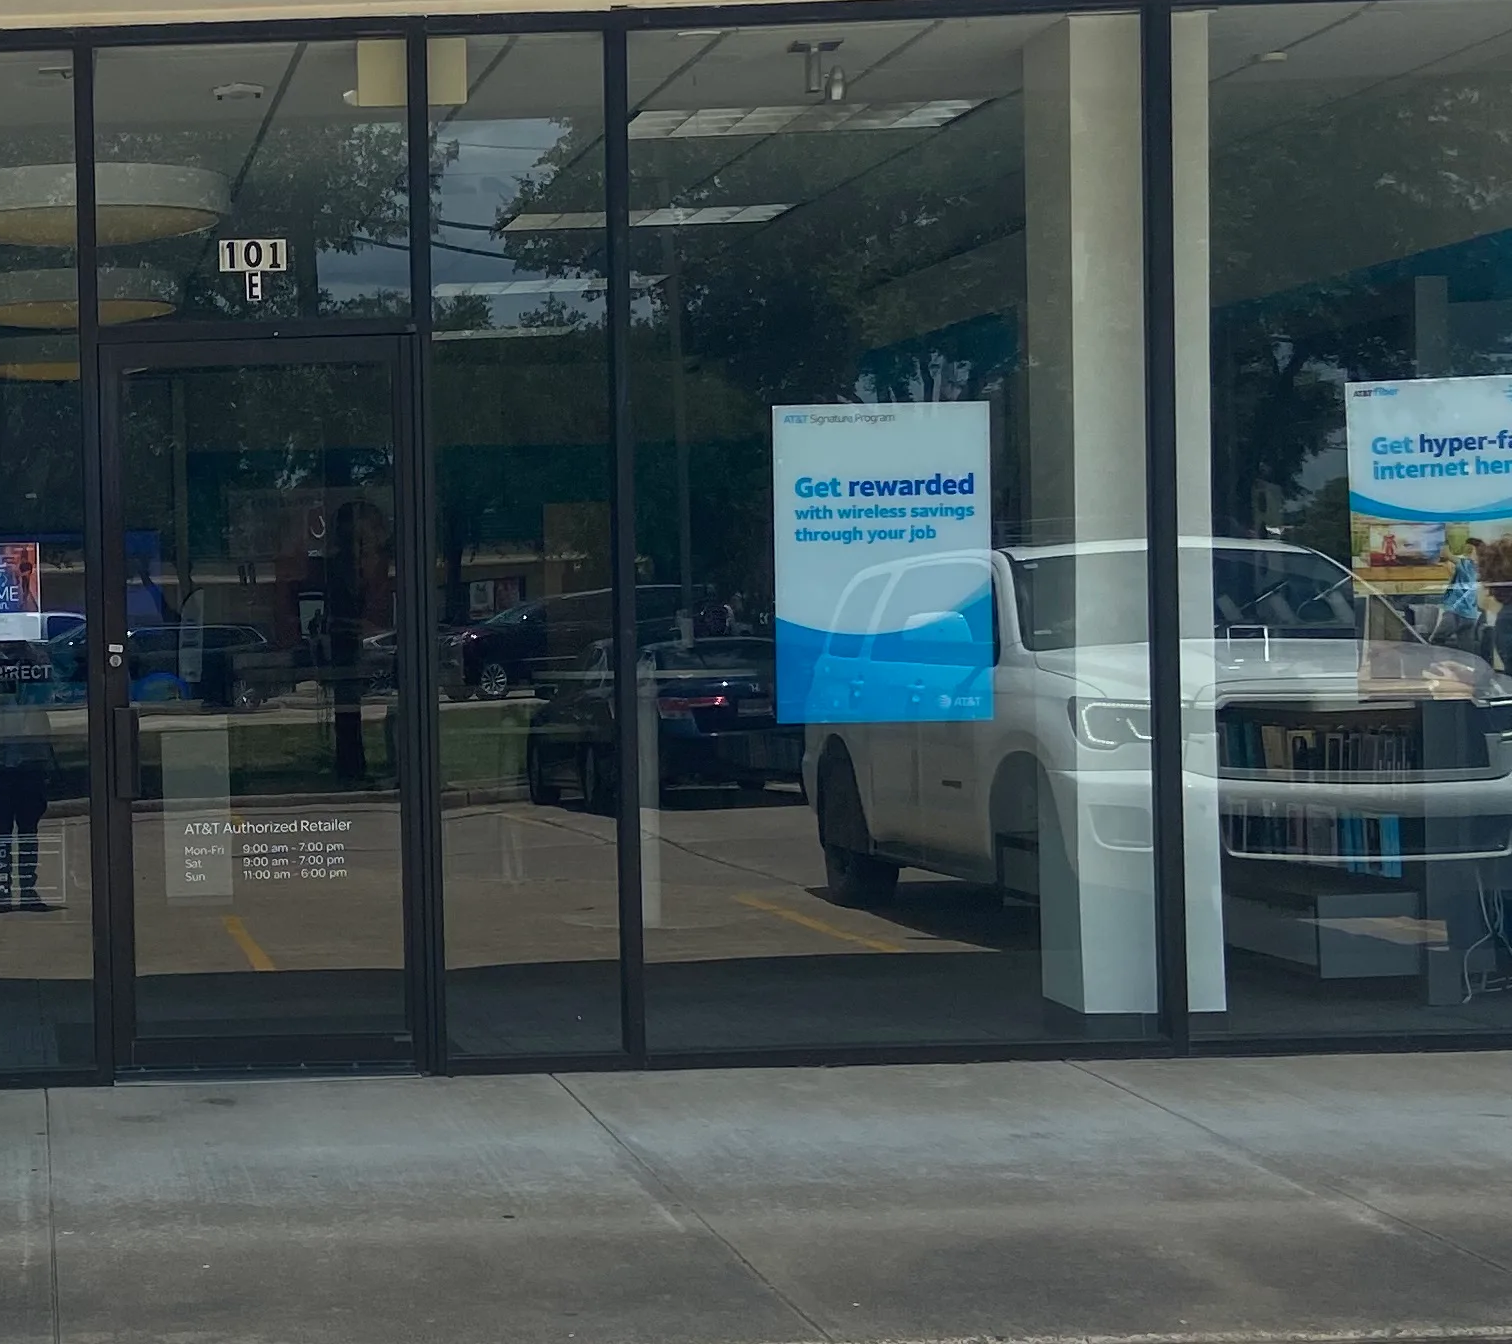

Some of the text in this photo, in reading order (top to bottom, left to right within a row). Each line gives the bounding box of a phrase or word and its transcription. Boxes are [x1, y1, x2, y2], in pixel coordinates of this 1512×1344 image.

[226, 241, 281, 269] 101
[248, 272, 260, 299] E
[809, 414, 853, 426] Signature
[854, 413, 896, 425] Program
[1372, 436, 1414, 455] Get
[1373, 458, 1469, 480] internet
[794, 472, 974, 498] Get rewarded
[795, 503, 975, 520] with wireless savings
[795, 525, 937, 544] through your job
[184, 818, 352, 836] AT&T Authorized Retailer
[184, 845, 225, 857] Mon-Fri
[242, 843, 268, 854] 9:00
[271, 845, 289, 854] am
[298, 842, 323, 853] 7:00
[326, 842, 345, 854] pm
[185, 859, 202, 870] Sat
[243, 857, 269, 868] 9:00
[271, 858, 289, 867] am
[298, 855, 324, 866] 7:00
[326, 856, 345, 867] pm
[185, 871, 206, 882] Sun
[243, 870, 271, 880] 11:00
[273, 871, 291, 880] am
[300, 868, 326, 879] 6:00
[329, 868, 348, 879] pm
